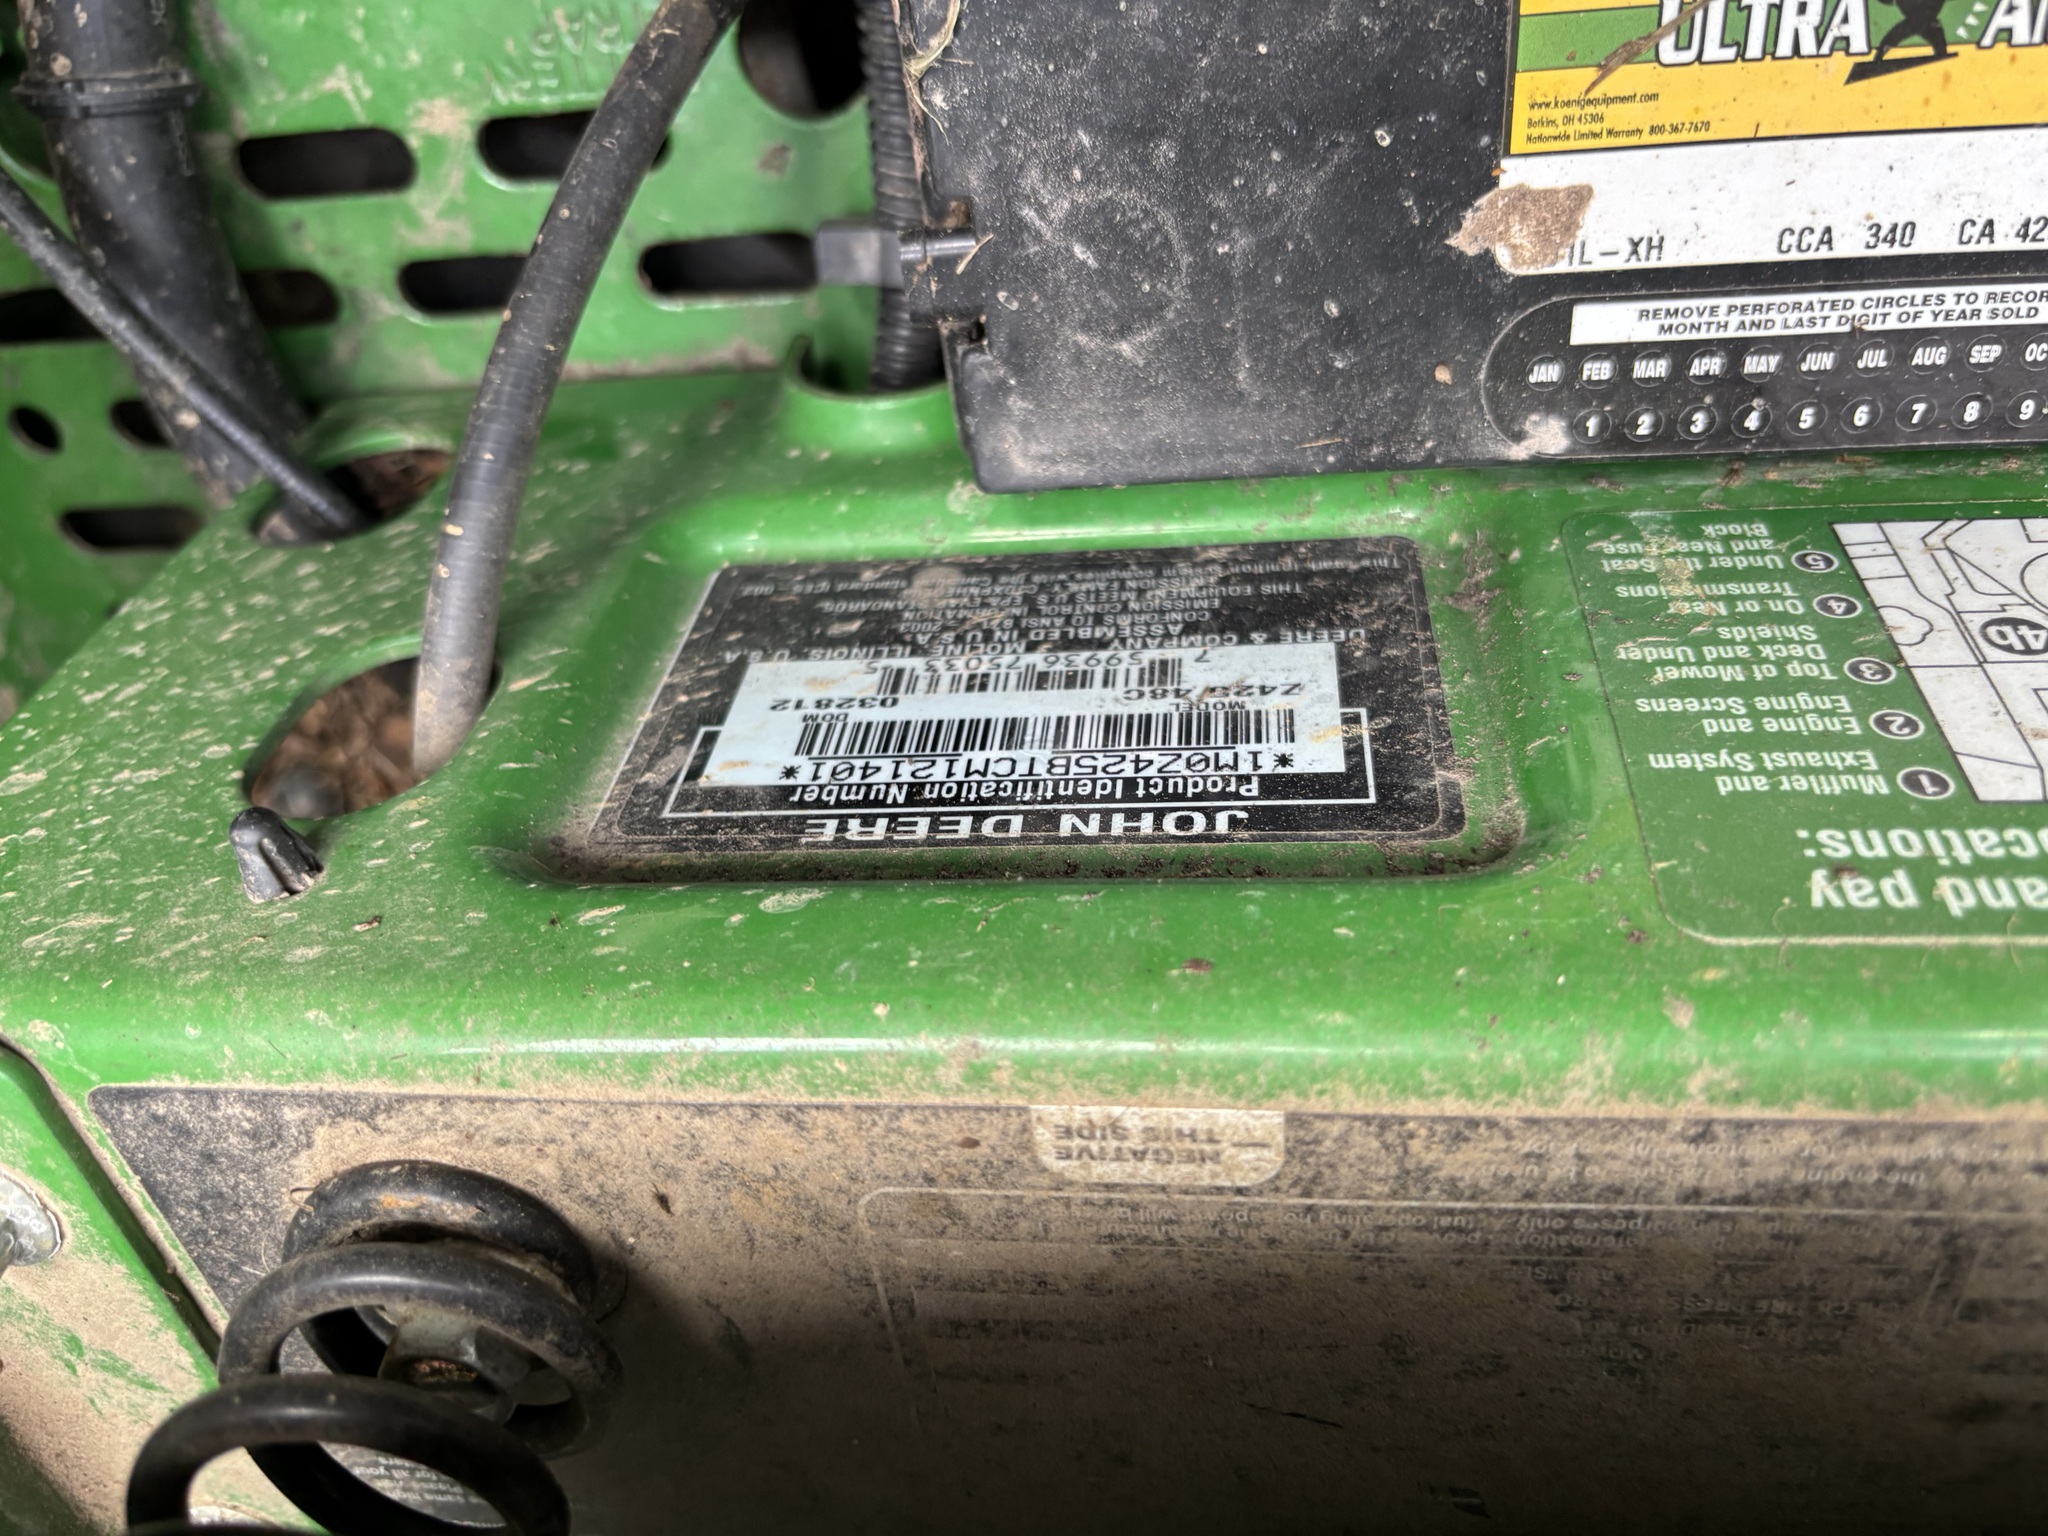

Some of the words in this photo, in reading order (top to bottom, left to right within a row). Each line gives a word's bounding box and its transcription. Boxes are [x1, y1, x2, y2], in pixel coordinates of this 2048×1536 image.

[1658, 0, 1870, 66] ULTRA
[1978, 0, 2048, 48] A
[1527, 91, 1661, 111] www.koenigequipment.com
[1527, 117, 1559, 130] Botkins,
[1561, 115, 1575, 127] OH
[1577, 112, 1604, 126] 45306
[1525, 131, 1571, 145] Nationwide
[1573, 128, 1605, 142] Limited
[1606, 126, 1644, 142] Warranty
[1647, 120, 1711, 136] 800-367-7670
[1777, 225, 1834, 255] CCA
[1864, 220, 1917, 250] 340
[1957, 217, 1995, 246] CA
[2014, 214, 2048, 244] 42
[1636, 304, 1720, 323] REMOVE
[1726, 298, 1855, 319] PERFORATED
[1861, 293, 1946, 311] CIRCLES
[1952, 291, 1979, 306] TO
[1657, 320, 1729, 337] MONTH
[1733, 318, 1777, 333] AND
[1780, 315, 1832, 331] LAST
[1836, 311, 1890, 329] DIGIT
[1896, 309, 1924, 324] OF
[1929, 308, 1982, 323] YEAR
[1985, 305, 2040, 321] SOLD
[1528, 362, 1561, 384] JAN
[1581, 359, 1613, 381] FEB
[1632, 357, 1668, 379] MAR
[1688, 355, 1721, 377] APR
[1742, 354, 1783, 375] MAY
[1799, 351, 1836, 372] JUN
[1856, 349, 1888, 370] JUL
[1910, 345, 1949, 366] AUG
[1968, 343, 2003, 364] SEP
[1585, 413, 1600, 438] 1
[1635, 411, 1656, 436] 2
[1689, 409, 1710, 434] 3
[1742, 408, 1762, 432] 4
[1798, 406, 1816, 430] 5
[1853, 404, 1871, 428] 6
[1911, 402, 1928, 425] 7
[1962, 400, 1981, 423] 8
[2019, 398, 2036, 421] 9
[1699, 523, 1772, 539] Block
[1730, 539, 1776, 554] and
[1600, 559, 1656, 574] Seat
[1709, 553, 1785, 571] Under
[1074, 590, 1138, 604] MEETS
[1260, 581, 1304, 595] THIS
[1037, 602, 1123, 616] CONTROL
[1128, 598, 1221, 613] EMISSION
[1733, 599, 1760, 613] or
[1770, 598, 1806, 614] On
[899, 620, 943, 633] 2003
[1019, 616, 1065, 629] ANSI
[1071, 615, 1094, 627] TO
[1102, 610, 1211, 627] CONFORMS
[987, 630, 1019, 643] IN
[1022, 623, 1184, 642] ASSEMBLED
[1248, 631, 1268, 645] &
[1278, 628, 1367, 644] DEERE
[1715, 623, 1819, 641] Shields
[1985, 624, 2048, 652] 4b
[1105, 633, 1239, 652] COMPANY
[1755, 642, 1828, 661] Deck
[1045, 652, 1144, 670] 59936
[1194, 651, 1213, 663] 7
[1614, 645, 1697, 662] Under
[1701, 644, 1751, 662] and
[924, 656, 1023, 676] 75033
[1653, 663, 1746, 684] Mower
[1750, 662, 1778, 682] of
[1783, 658, 1839, 681] Top
[768, 696, 899, 712] 032812
[1122, 688, 1194, 702] 48C
[1752, 690, 1852, 714] Engine
[1169, 701, 1247, 713] MODEL
[1634, 695, 1748, 716] Screens
[801, 712, 848, 723] DOM
[1701, 717, 1754, 737] and
[1761, 712, 1863, 736] Engine
[1647, 747, 1755, 773] System
[1758, 749, 1880, 772] Exhaust
[788, 783, 908, 806] Number
[923, 778, 1123, 805] Identification
[1135, 775, 1260, 798] Product
[1714, 774, 1771, 797] and
[1778, 773, 1891, 797] Muffler
[797, 811, 1027, 844] DEERE
[1059, 809, 1251, 838] JOHN
[1795, 827, 2048, 867] cations:
[1810, 868, 1922, 909] pay
[1934, 875, 2048, 918] and
[1053, 1123, 1129, 1142] SIDE
[1138, 1125, 1222, 1144] THIS
[1053, 1145, 1222, 1166] NEGATIVE
